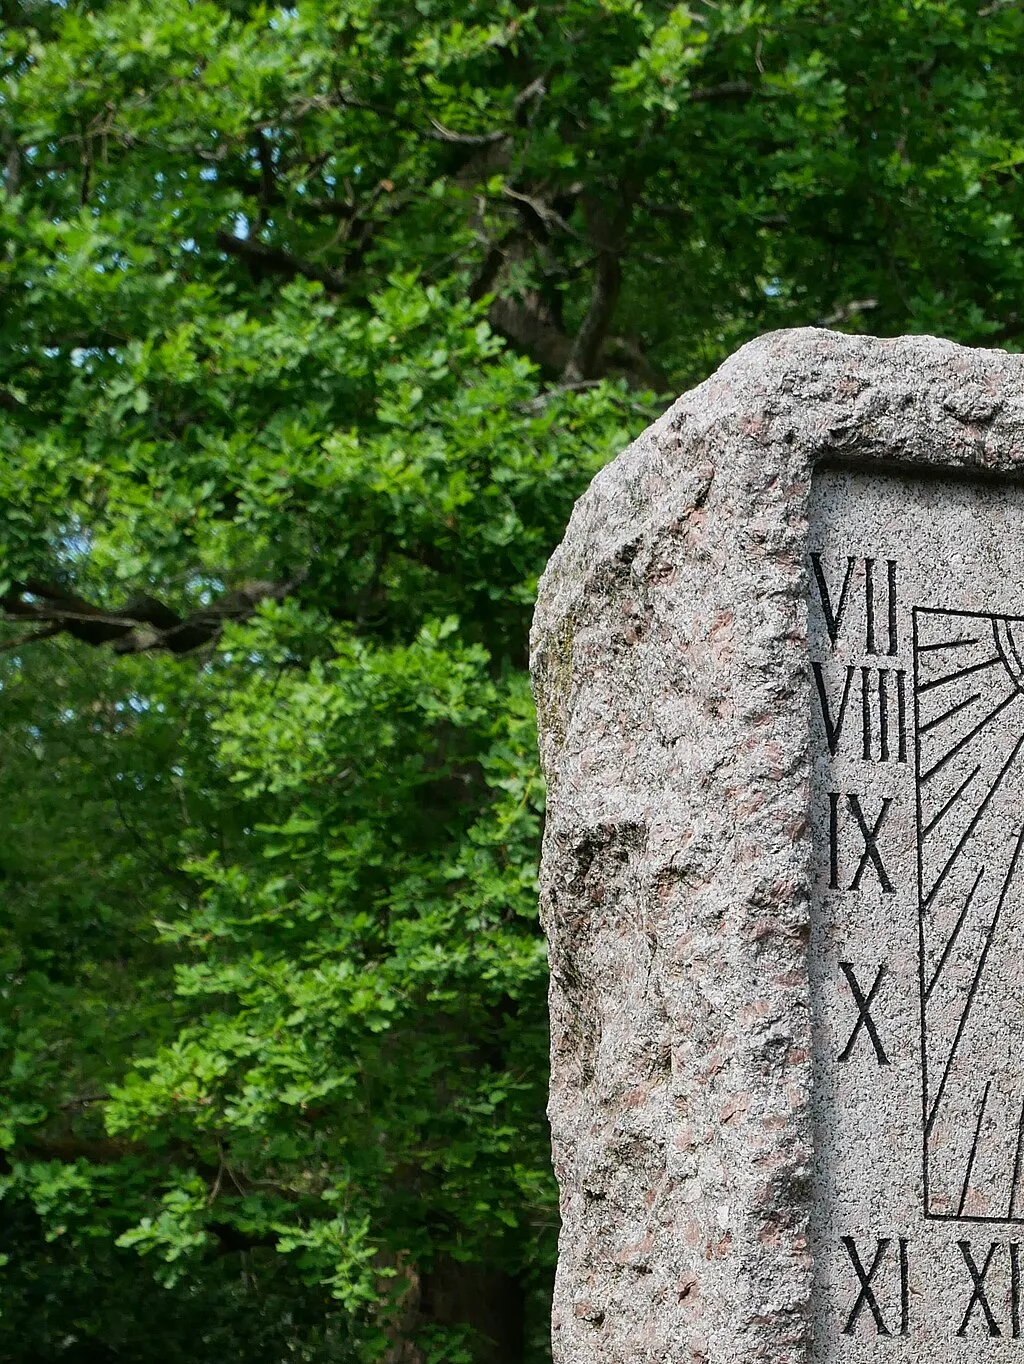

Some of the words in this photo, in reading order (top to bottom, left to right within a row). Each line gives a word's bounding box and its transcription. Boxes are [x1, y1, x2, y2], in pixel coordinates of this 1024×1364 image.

[809, 552, 898, 656] VII
[811, 661, 907, 763] VIII
[827, 792, 897, 894] IX
[837, 962, 892, 1065] X
[840, 1235, 910, 1338] XI
